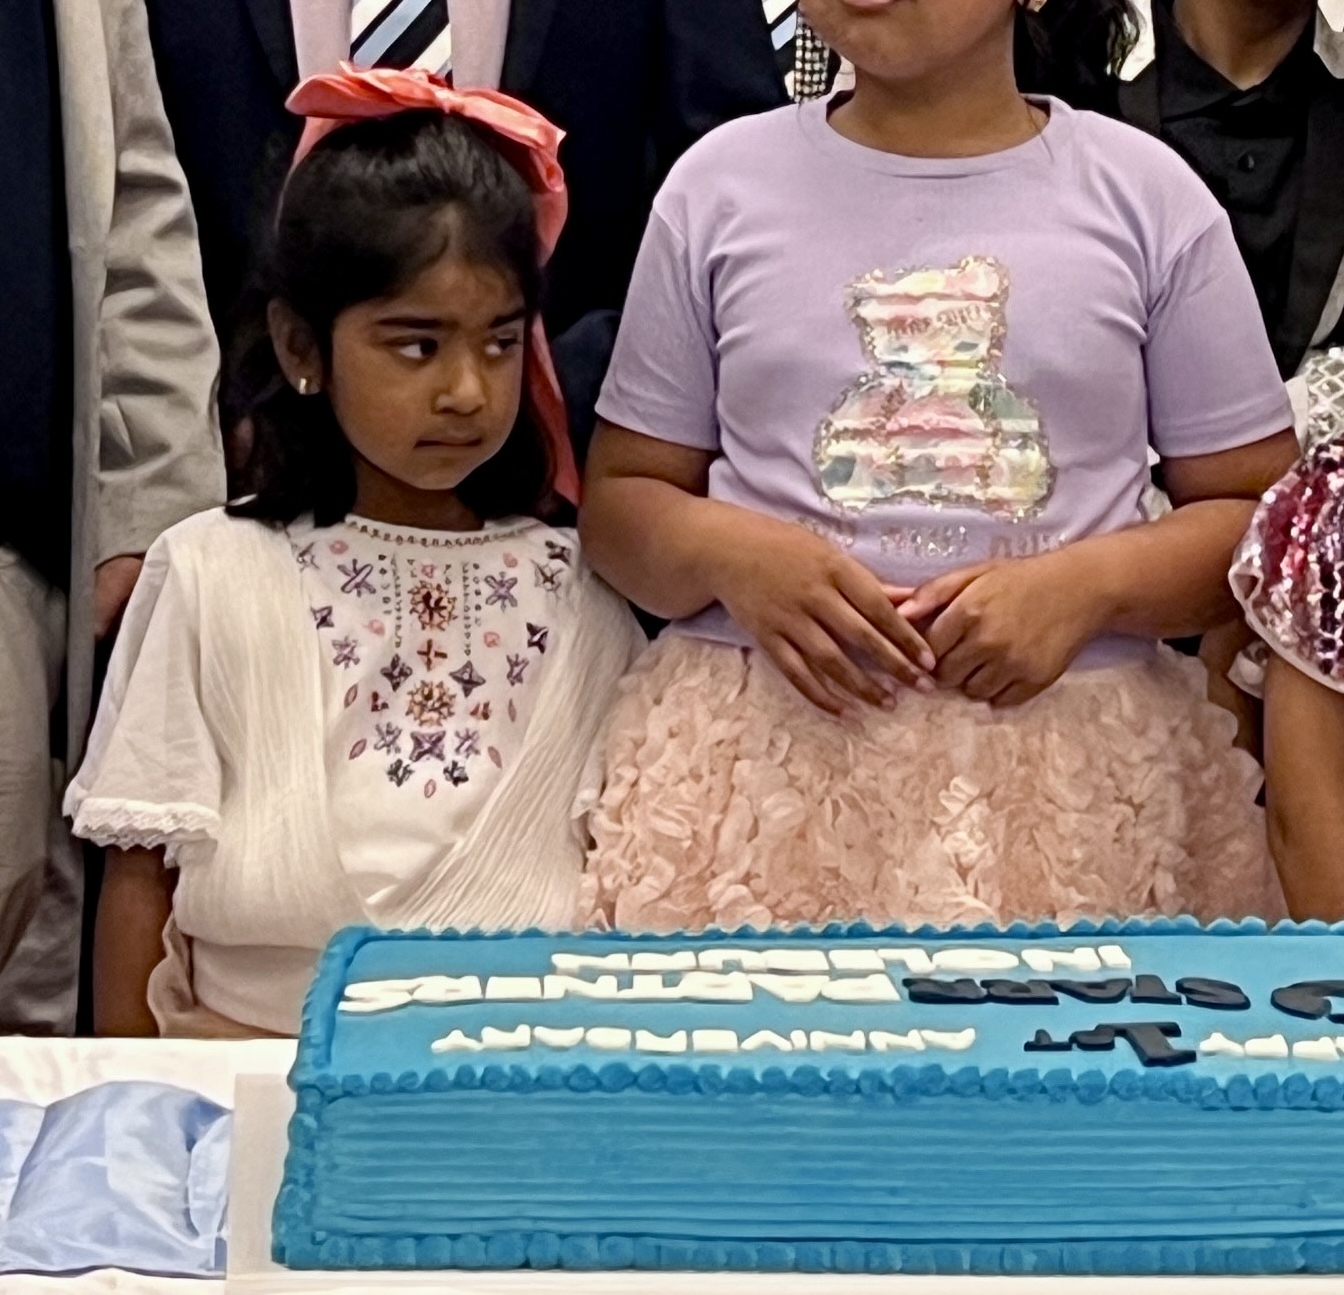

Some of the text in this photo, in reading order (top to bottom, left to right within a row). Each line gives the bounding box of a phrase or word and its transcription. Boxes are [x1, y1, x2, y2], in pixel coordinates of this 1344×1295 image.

[551, 946, 1132, 972] INGLEBURN
[338, 973, 1251, 1012] STARR PARTNERS
[430, 1023, 976, 1053] ANNIVERSARY
